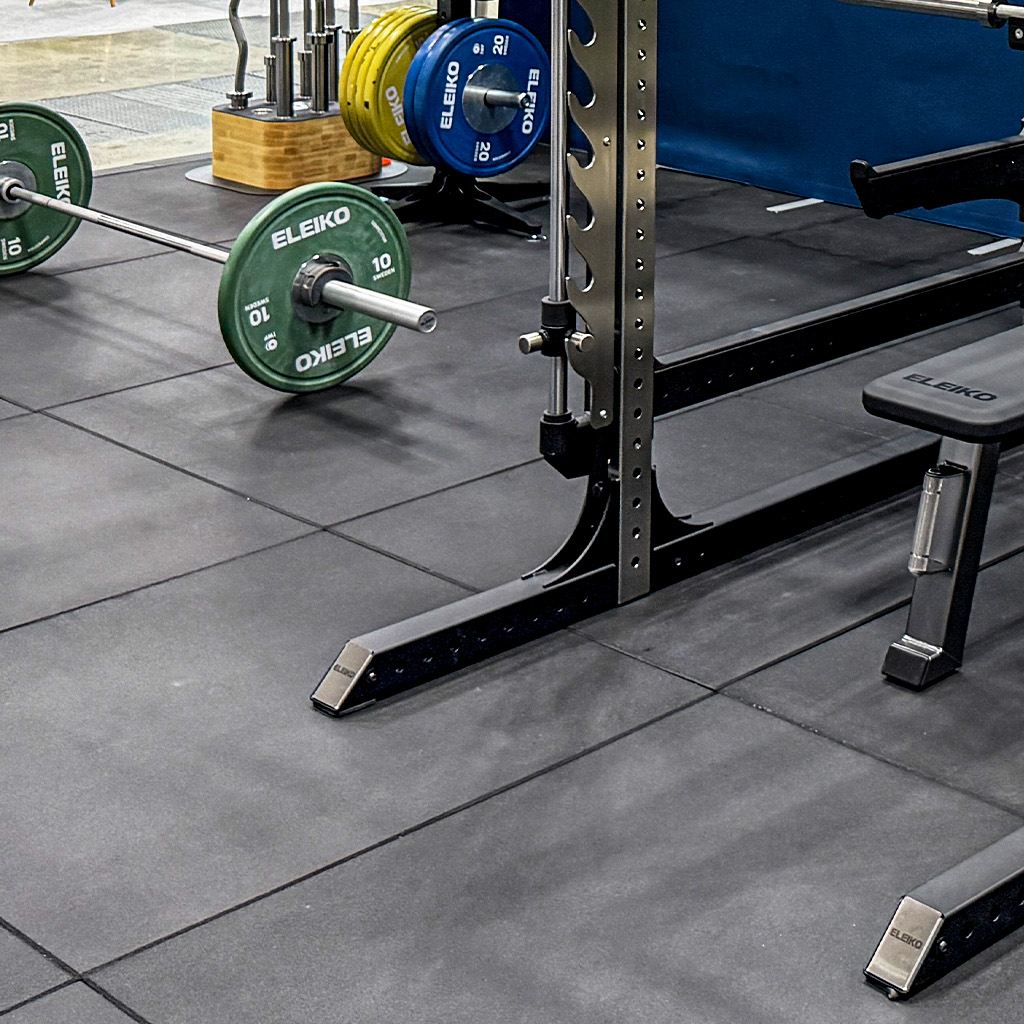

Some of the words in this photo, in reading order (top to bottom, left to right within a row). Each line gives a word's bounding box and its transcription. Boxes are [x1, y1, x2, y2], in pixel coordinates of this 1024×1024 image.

[492, 35, 504, 55] 20
[440, 61, 460, 130] ELEIKO
[478, 142, 491, 162] 20
[271, 206, 350, 250] ELEIKO
[7, 236, 22, 256] 10
[372, 253, 392, 273] 10
[372, 268, 396, 282] SWEDEN
[250, 306, 270, 326] 10
[295, 326, 373, 372] ELEIKO
[903, 374, 998, 402] ELEIKO
[890, 928, 924, 950] ELEIKO
